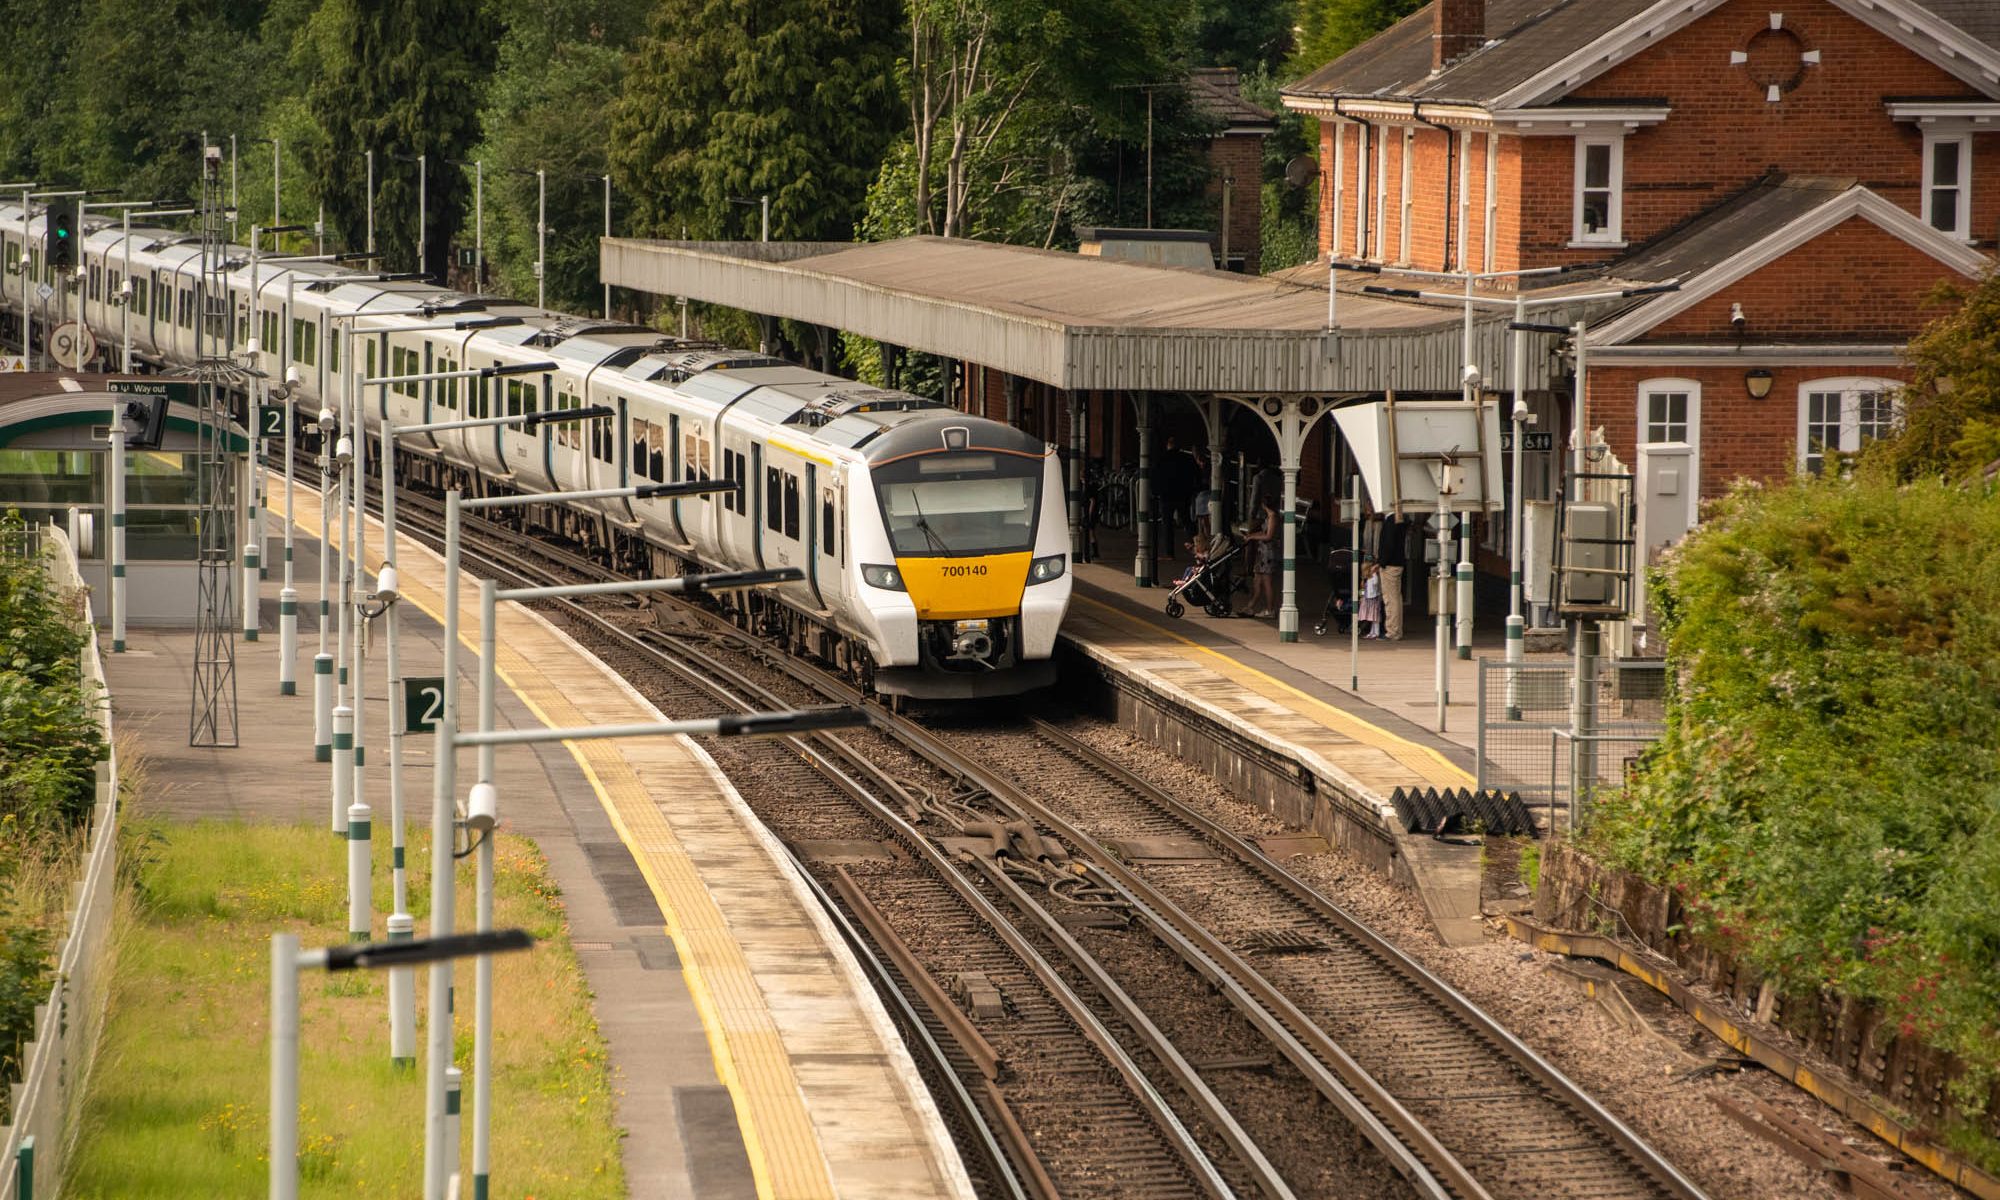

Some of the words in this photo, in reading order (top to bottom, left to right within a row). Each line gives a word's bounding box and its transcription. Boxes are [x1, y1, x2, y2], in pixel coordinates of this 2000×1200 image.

[134, 384, 151, 395] Way
[152, 384, 166, 393] out
[267, 410, 281, 433] 2
[941, 564, 988, 577] 700140
[420, 686, 443, 724] 2
